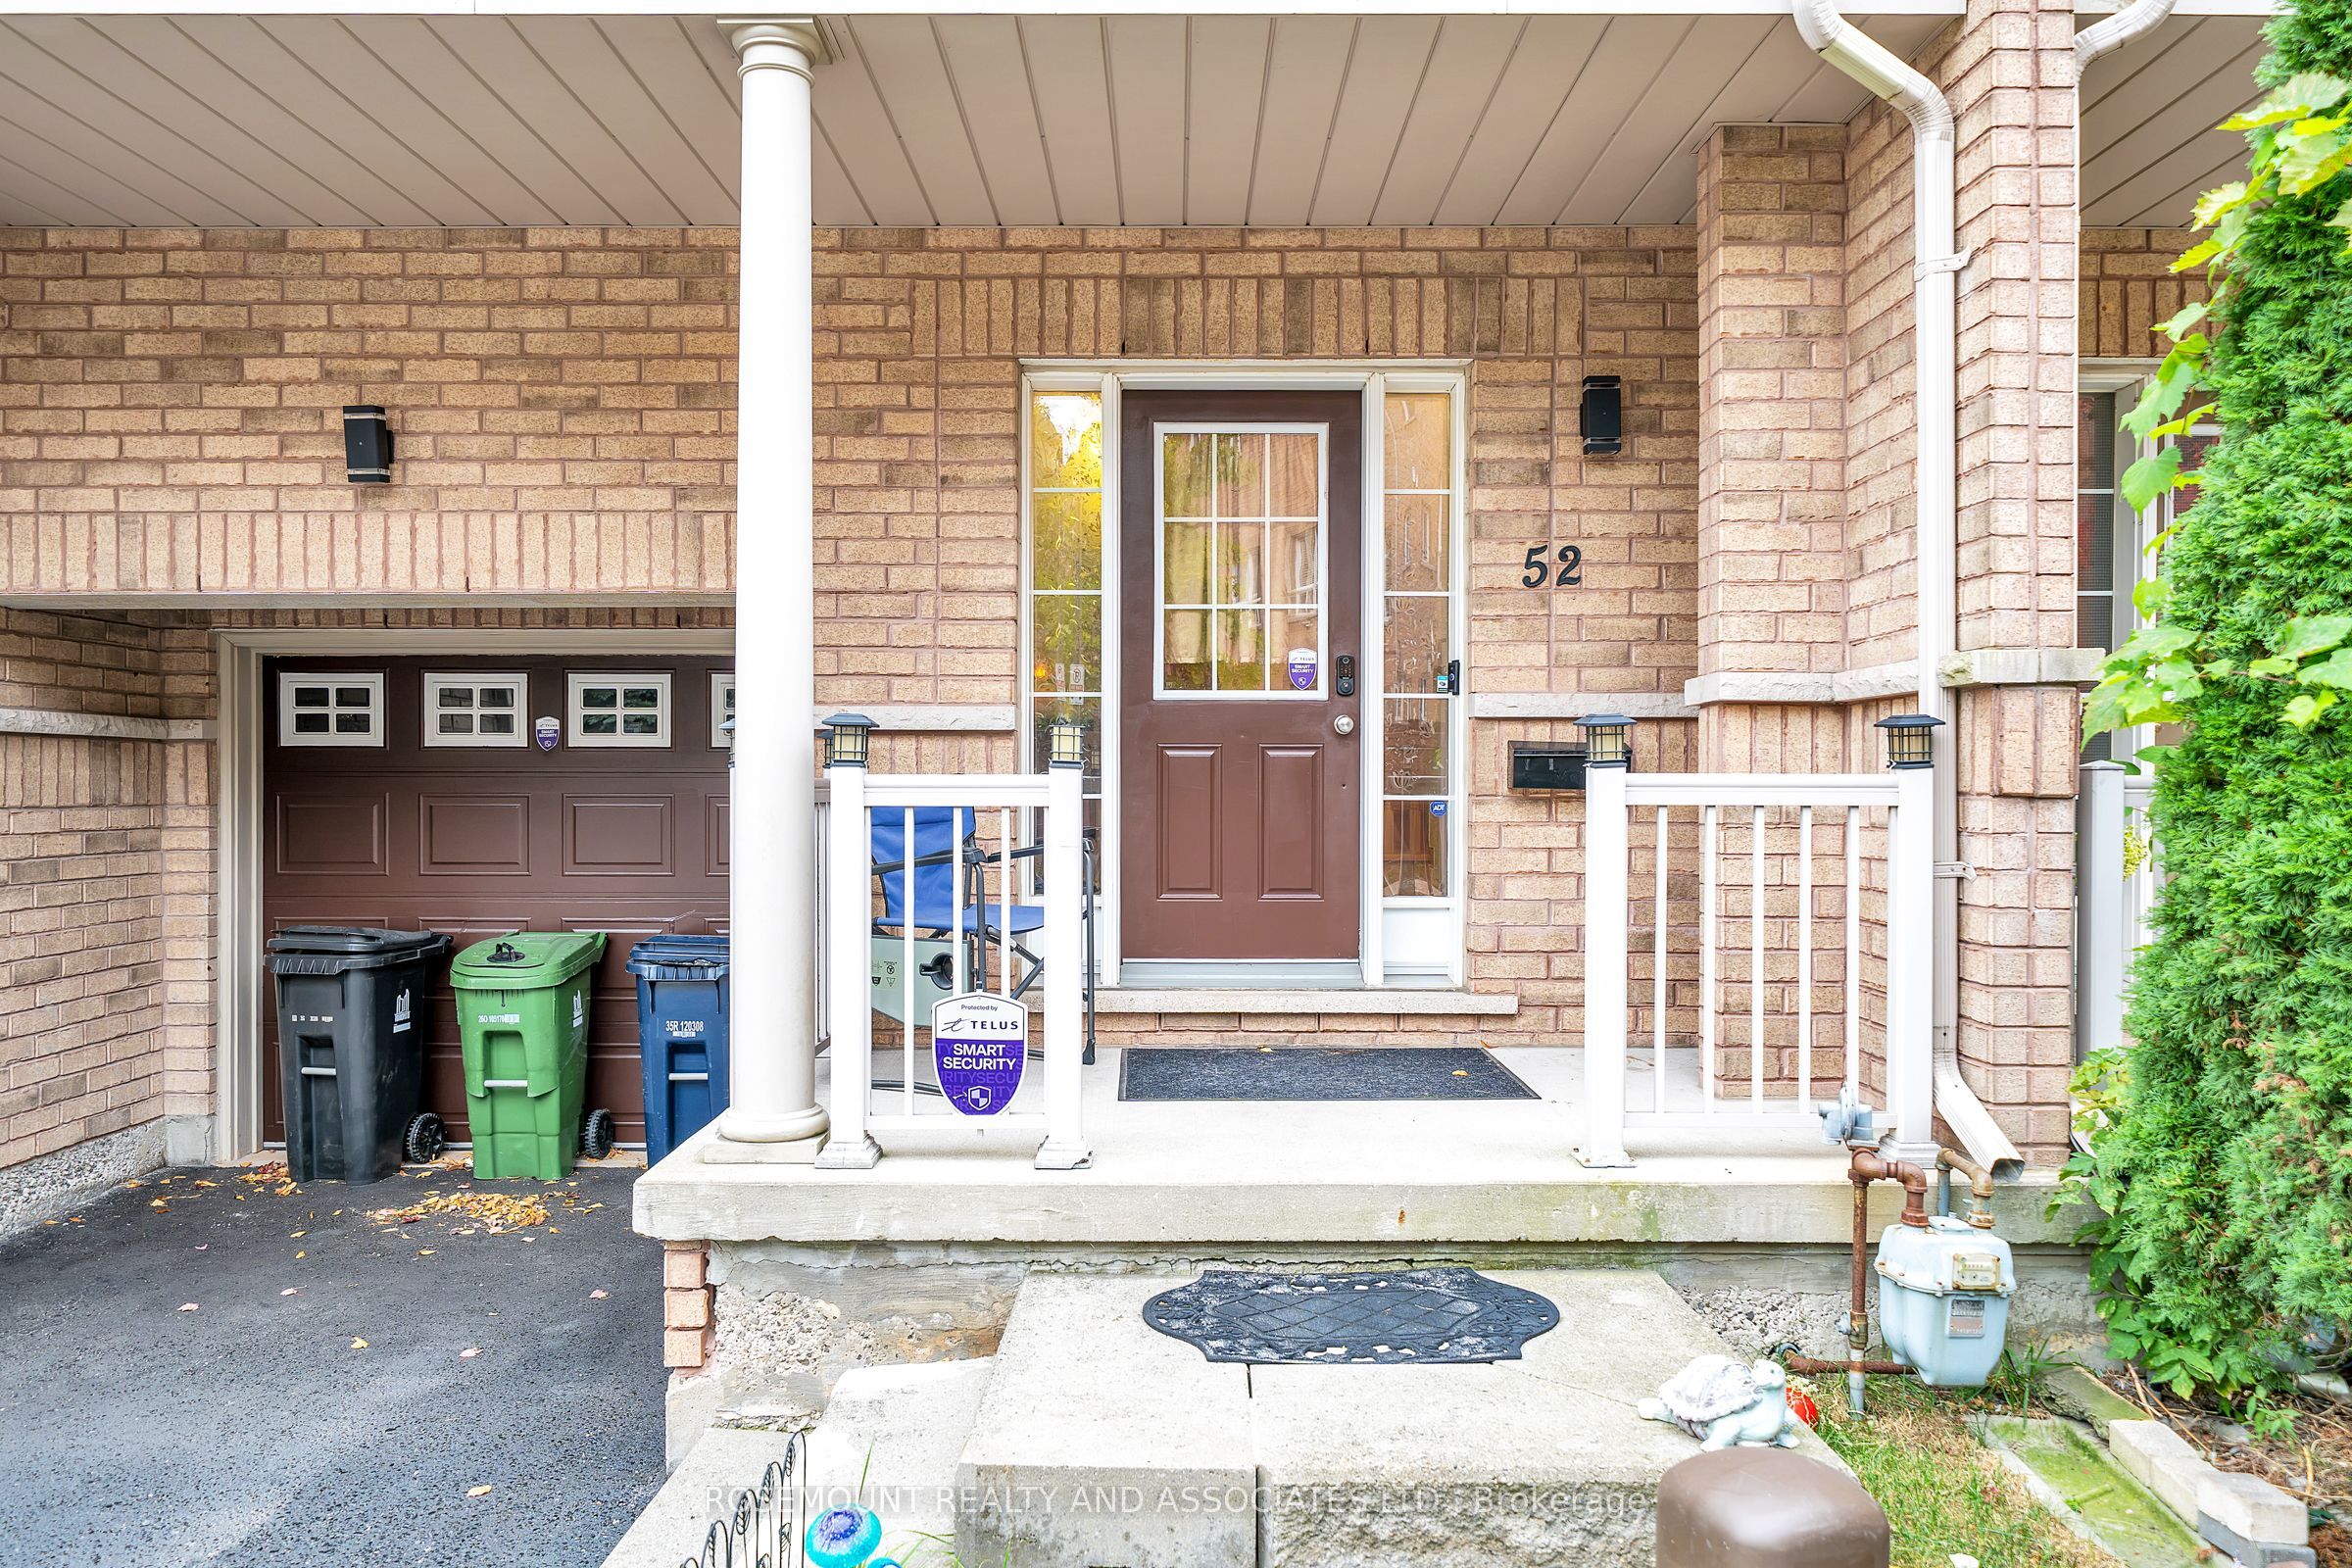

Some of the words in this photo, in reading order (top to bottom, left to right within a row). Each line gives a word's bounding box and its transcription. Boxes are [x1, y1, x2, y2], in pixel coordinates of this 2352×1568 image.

[1522, 544, 1582, 588] 52
[989, 1004, 999, 1012] by
[665, 1020, 679, 1032] 35R
[970, 1020, 1019, 1030] TELUS
[953, 1043, 1006, 1056] SMART
[943, 1056, 1017, 1070] SECURITY
